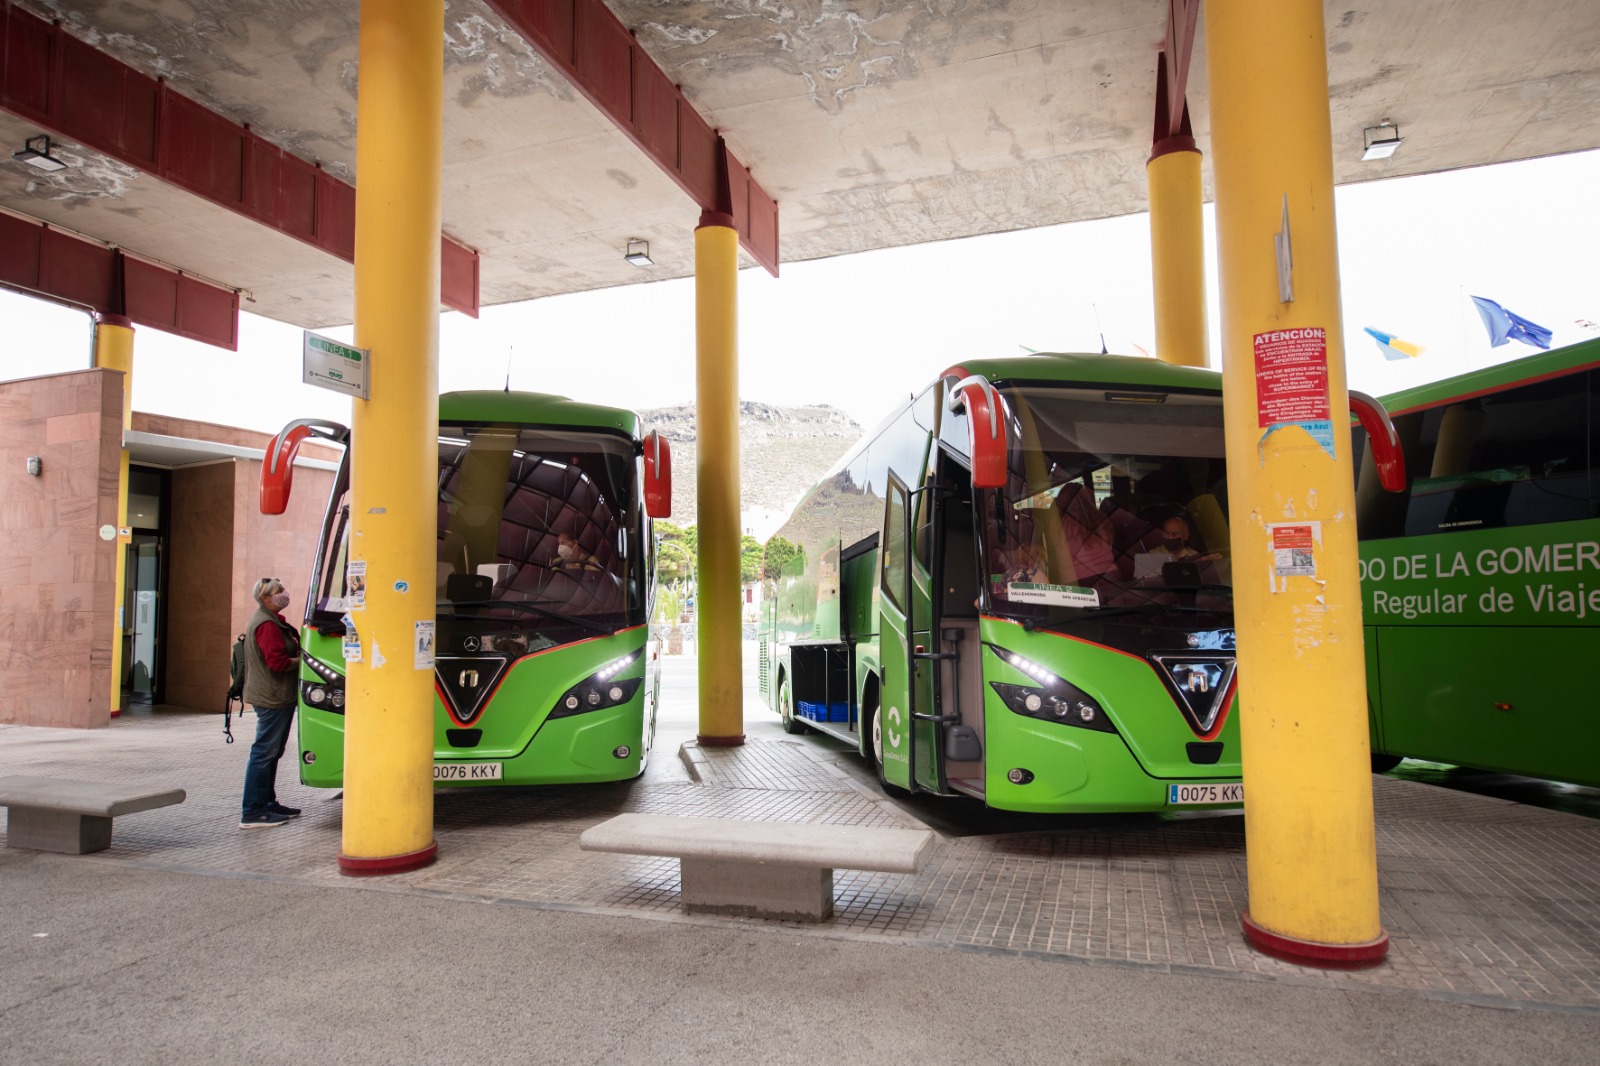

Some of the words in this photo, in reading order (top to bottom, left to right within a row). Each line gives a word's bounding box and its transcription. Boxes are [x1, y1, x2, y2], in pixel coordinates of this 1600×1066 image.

[1255, 328, 1325, 345] ATENCIÓN:
[1259, 341, 1287, 349] USUARIOS
[347, 350, 352, 359] 1
[1266, 348, 1304, 356] ENCUENTRAN
[1273, 383, 1315, 392] SUPERMARKET
[1393, 555, 1427, 580] DE
[1436, 552, 1470, 578] LA
[1373, 588, 1468, 619] Regular
[1479, 587, 1515, 613] de
[433, 766, 466, 778] 0076
[471, 765, 497, 778] KKY
[1181, 786, 1217, 801] 0075
